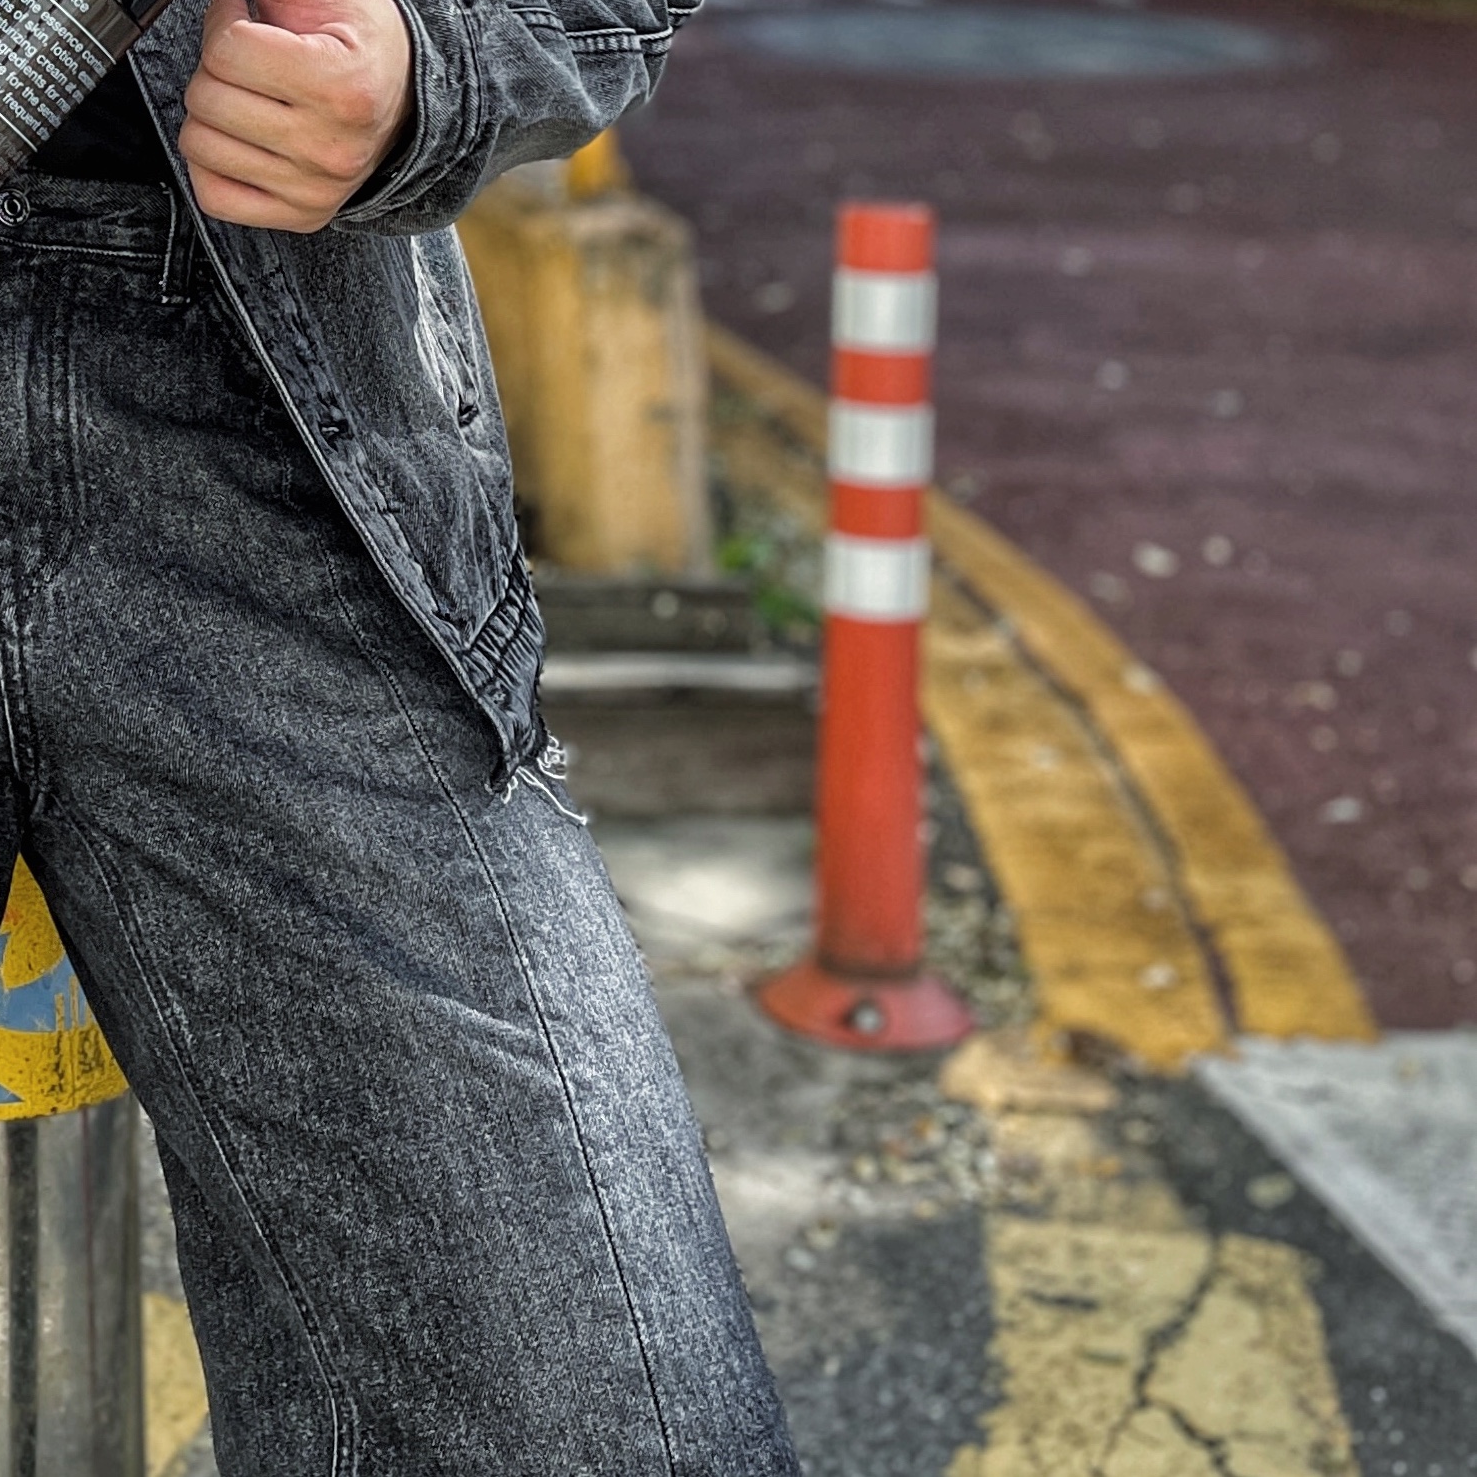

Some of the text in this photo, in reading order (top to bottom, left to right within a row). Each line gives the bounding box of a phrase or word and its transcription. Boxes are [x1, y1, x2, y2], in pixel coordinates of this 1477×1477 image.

[12, 7, 28, 23] of
[22, 17, 53, 46] skin,
[48, 41, 83, 74] lotion,
[38, 10, 85, 53] essence
[5, 70, 25, 91] for
[20, 85, 42, 106] the
[34, 53, 69, 85] cream
[44, 82, 62, 101] for
[0, 91, 43, 132] frequent
